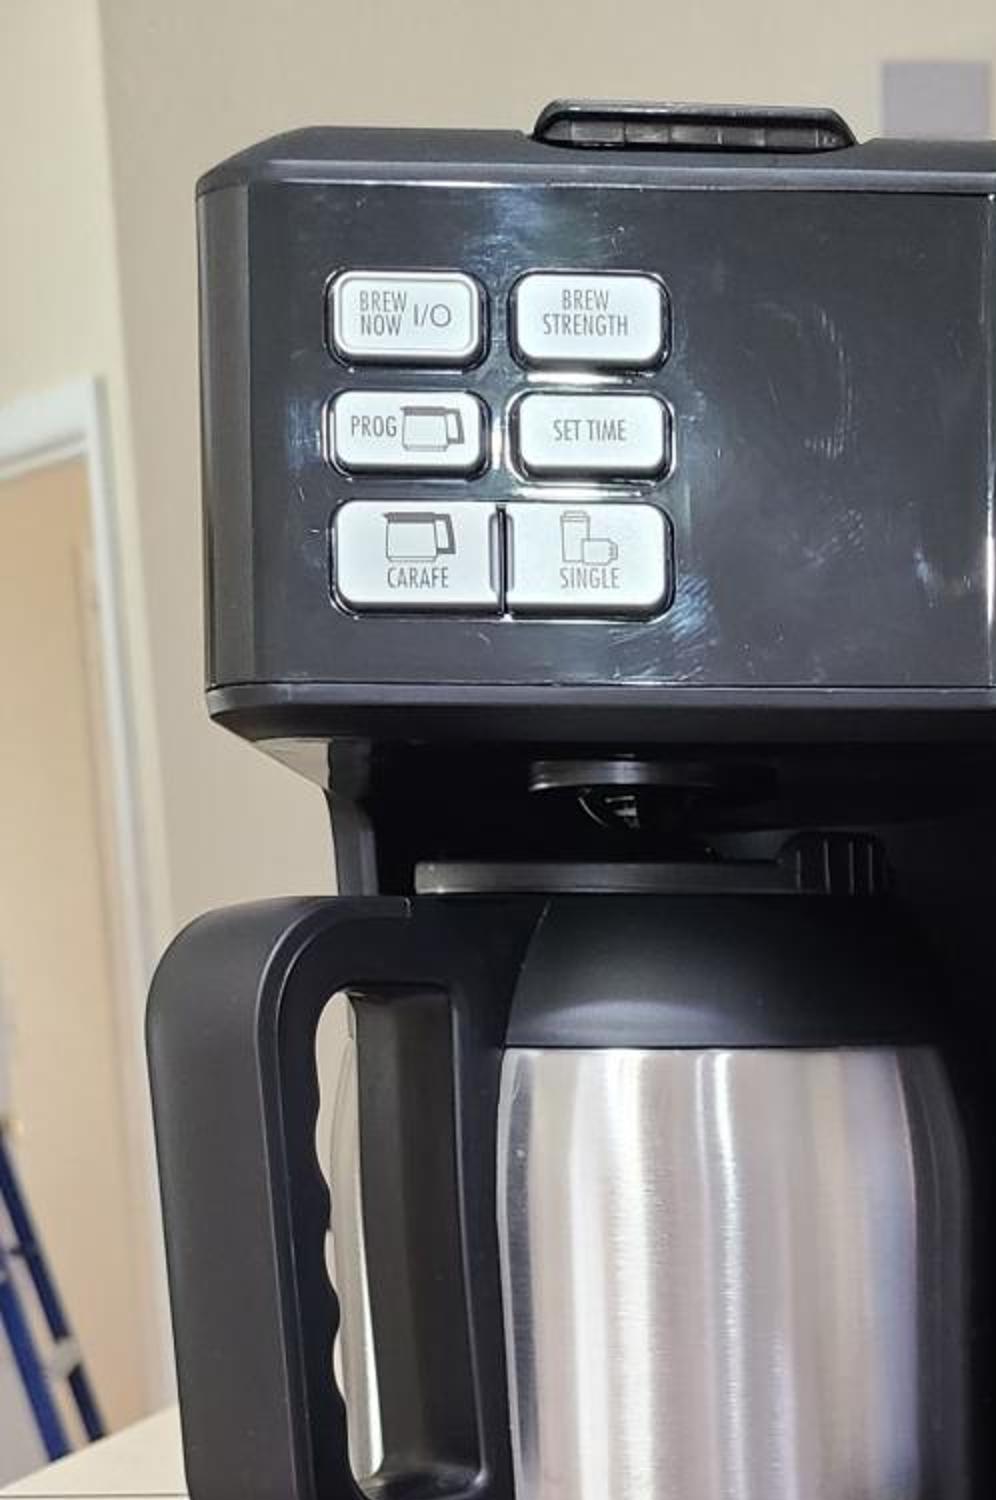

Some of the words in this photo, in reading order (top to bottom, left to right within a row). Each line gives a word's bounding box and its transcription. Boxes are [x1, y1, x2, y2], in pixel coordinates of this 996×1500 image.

[359, 290, 408, 311] BREW
[561, 289, 610, 310] BREW
[359, 316, 402, 337] NOW
[543, 314, 628, 337] STRENGTH
[350, 415, 397, 437] PROG
[553, 420, 581, 441] SET
[585, 420, 627, 441] TIME
[387, 566, 449, 589] CARAFE
[559, 567, 620, 589] SINGLE
